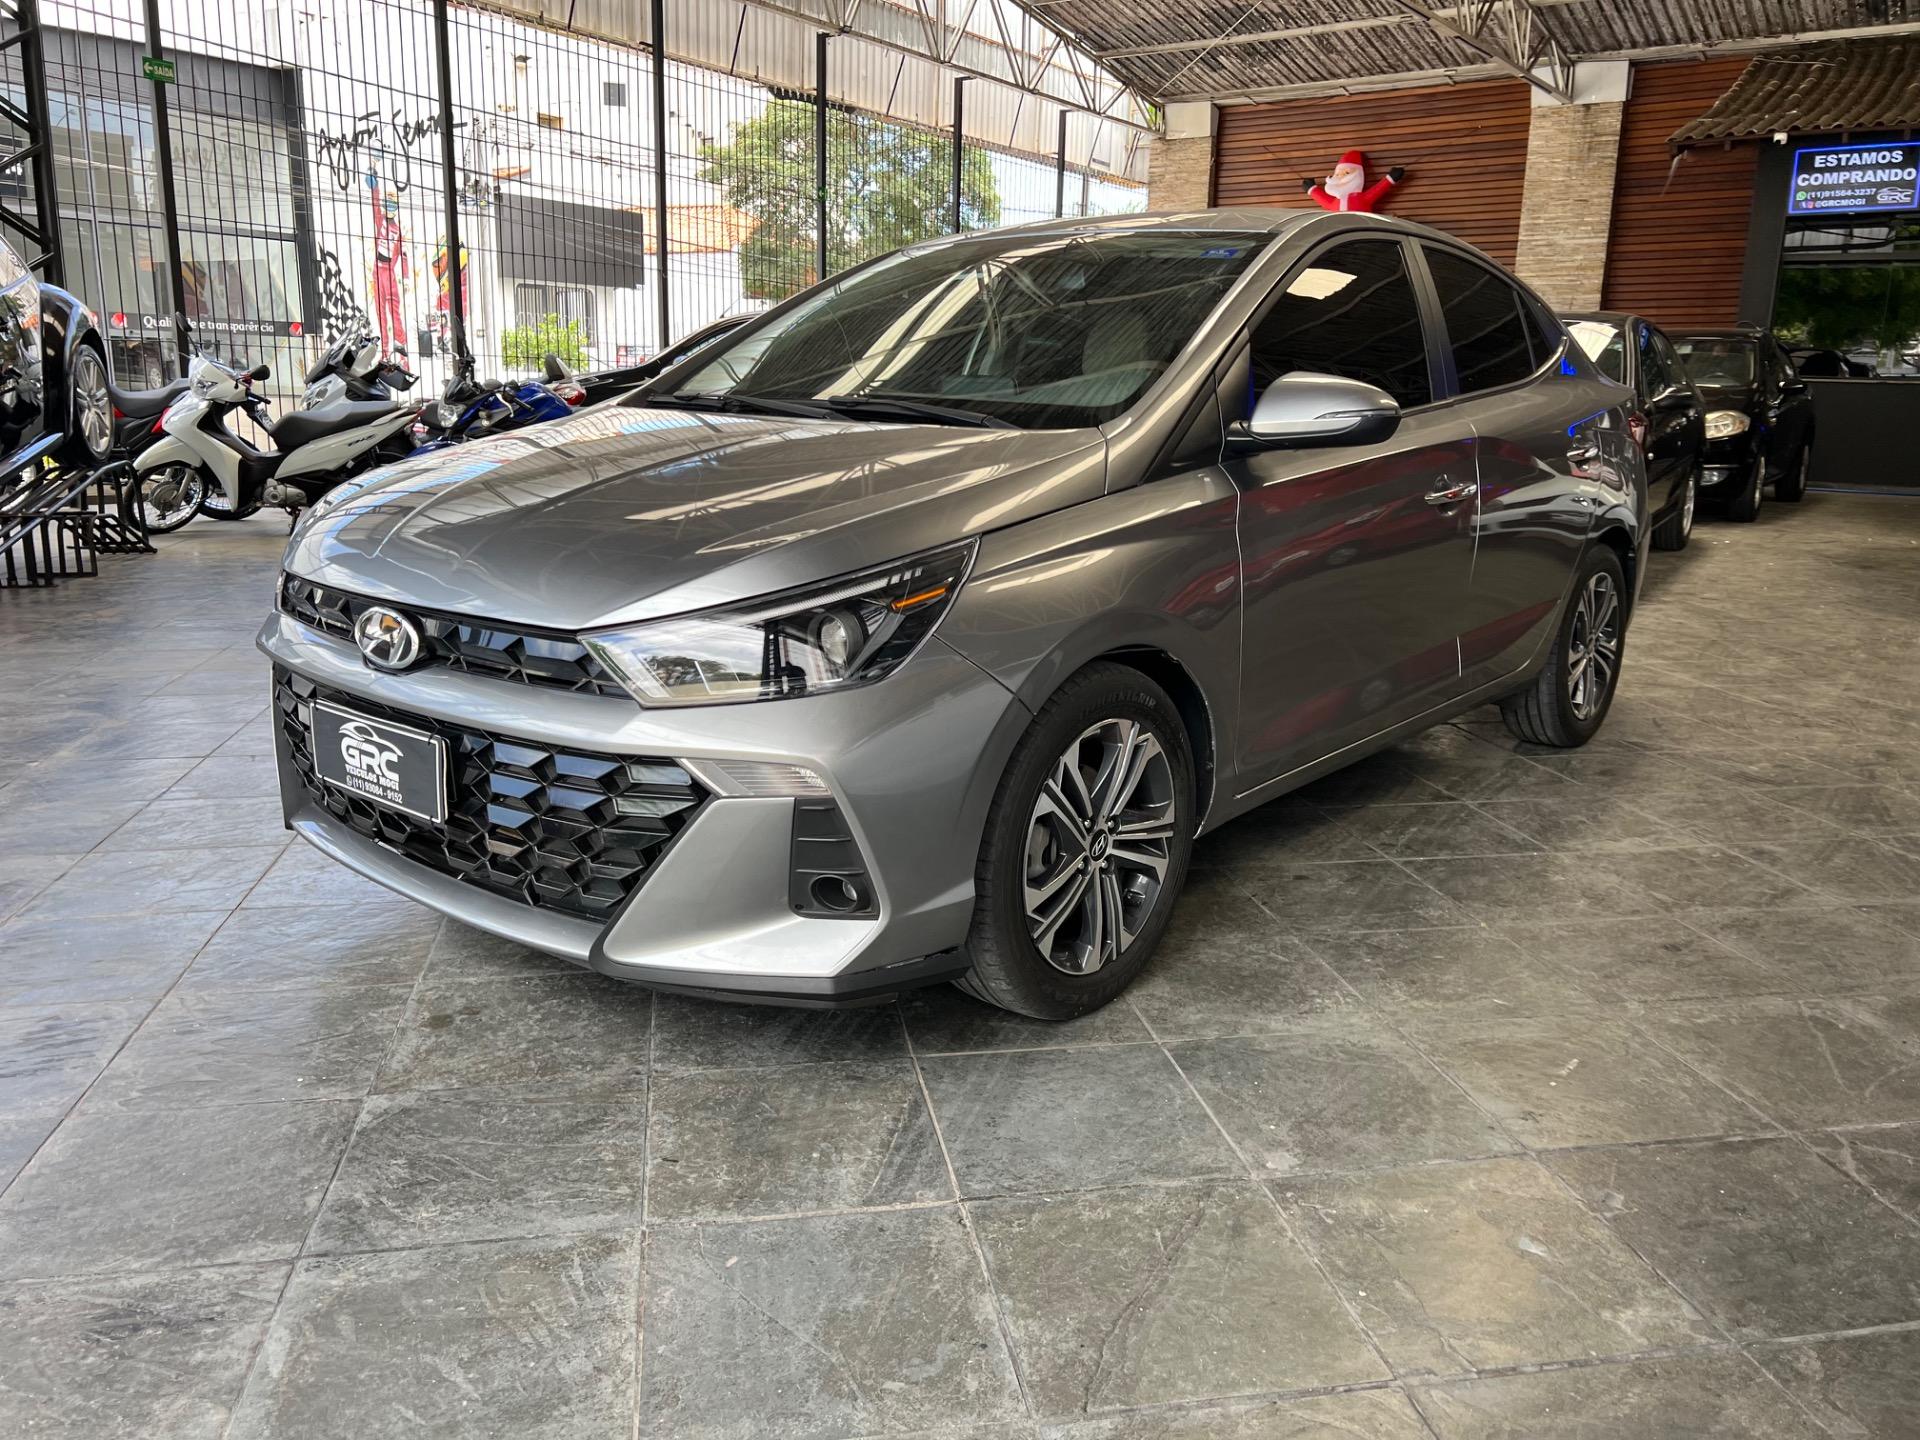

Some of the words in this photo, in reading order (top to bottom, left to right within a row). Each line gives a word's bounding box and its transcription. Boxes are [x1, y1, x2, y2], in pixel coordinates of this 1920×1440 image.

[391, 108, 468, 192] Senn
[1814, 150, 1904, 168] ESTAMOS
[1797, 167, 1917, 187] COMPRANDO
[1876, 191, 1912, 203] GRC
[341, 736, 400, 783] GRC
